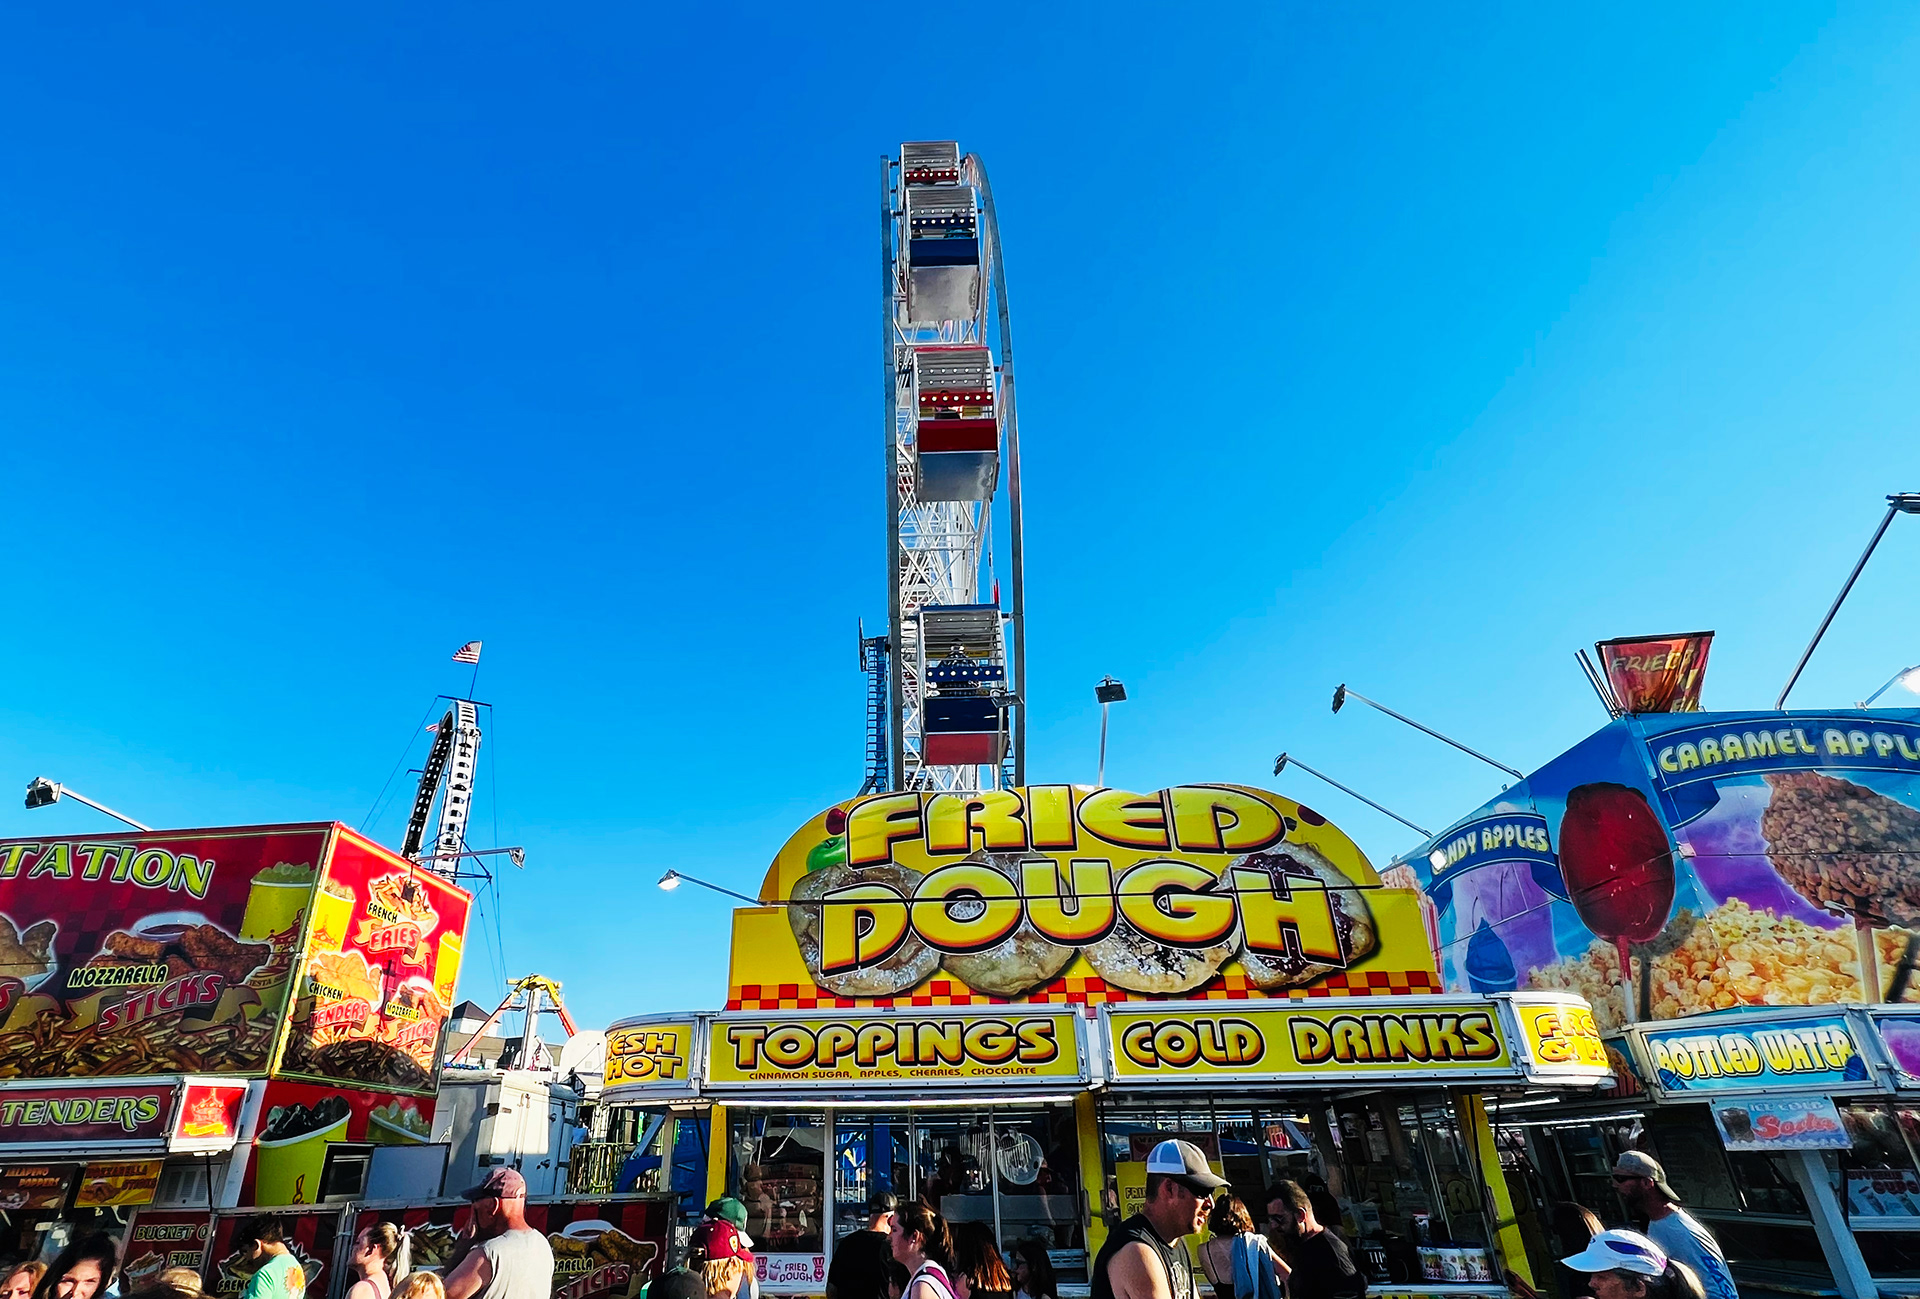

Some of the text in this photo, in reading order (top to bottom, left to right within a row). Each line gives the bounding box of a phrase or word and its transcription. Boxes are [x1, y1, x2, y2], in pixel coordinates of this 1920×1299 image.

[1658, 728, 1817, 774] CARAMEL
[845, 784, 1287, 869] FRIED
[1431, 824, 1550, 875] NDY APPLES
[0, 842, 215, 899] TATION
[368, 902, 399, 924] FRENCH
[820, 858, 1347, 979] DOUGH
[369, 928, 419, 950] FRIES
[67, 964, 169, 988] MOZZARELLA
[97, 974, 225, 1032] STICKS
[309, 983, 343, 1001] CHICKEN
[309, 1001, 369, 1026] TENDERS
[399, 1021, 438, 1044] STICKS
[728, 1018, 1060, 1071] TOPPINGS
[1121, 1012, 1502, 1069] COLD DRINKS
[1538, 1037, 1581, 1062] &
[1651, 1027, 1855, 1081] BOTTLED WATER
[607, 1055, 683, 1081] HOT
[748, 1067, 1037, 1081] CINNAMON SUGAR, APPLES, CHERRIES, CHOCOLATE
[1, 1096, 160, 1132] TENDERS
[1779, 1101, 1824, 1111] COLD
[134, 1224, 196, 1241] BUCKET
[779, 1273, 813, 1282] DOUGH
[785, 1263, 808, 1271] FRIED
[556, 1263, 631, 1299] STICKS
